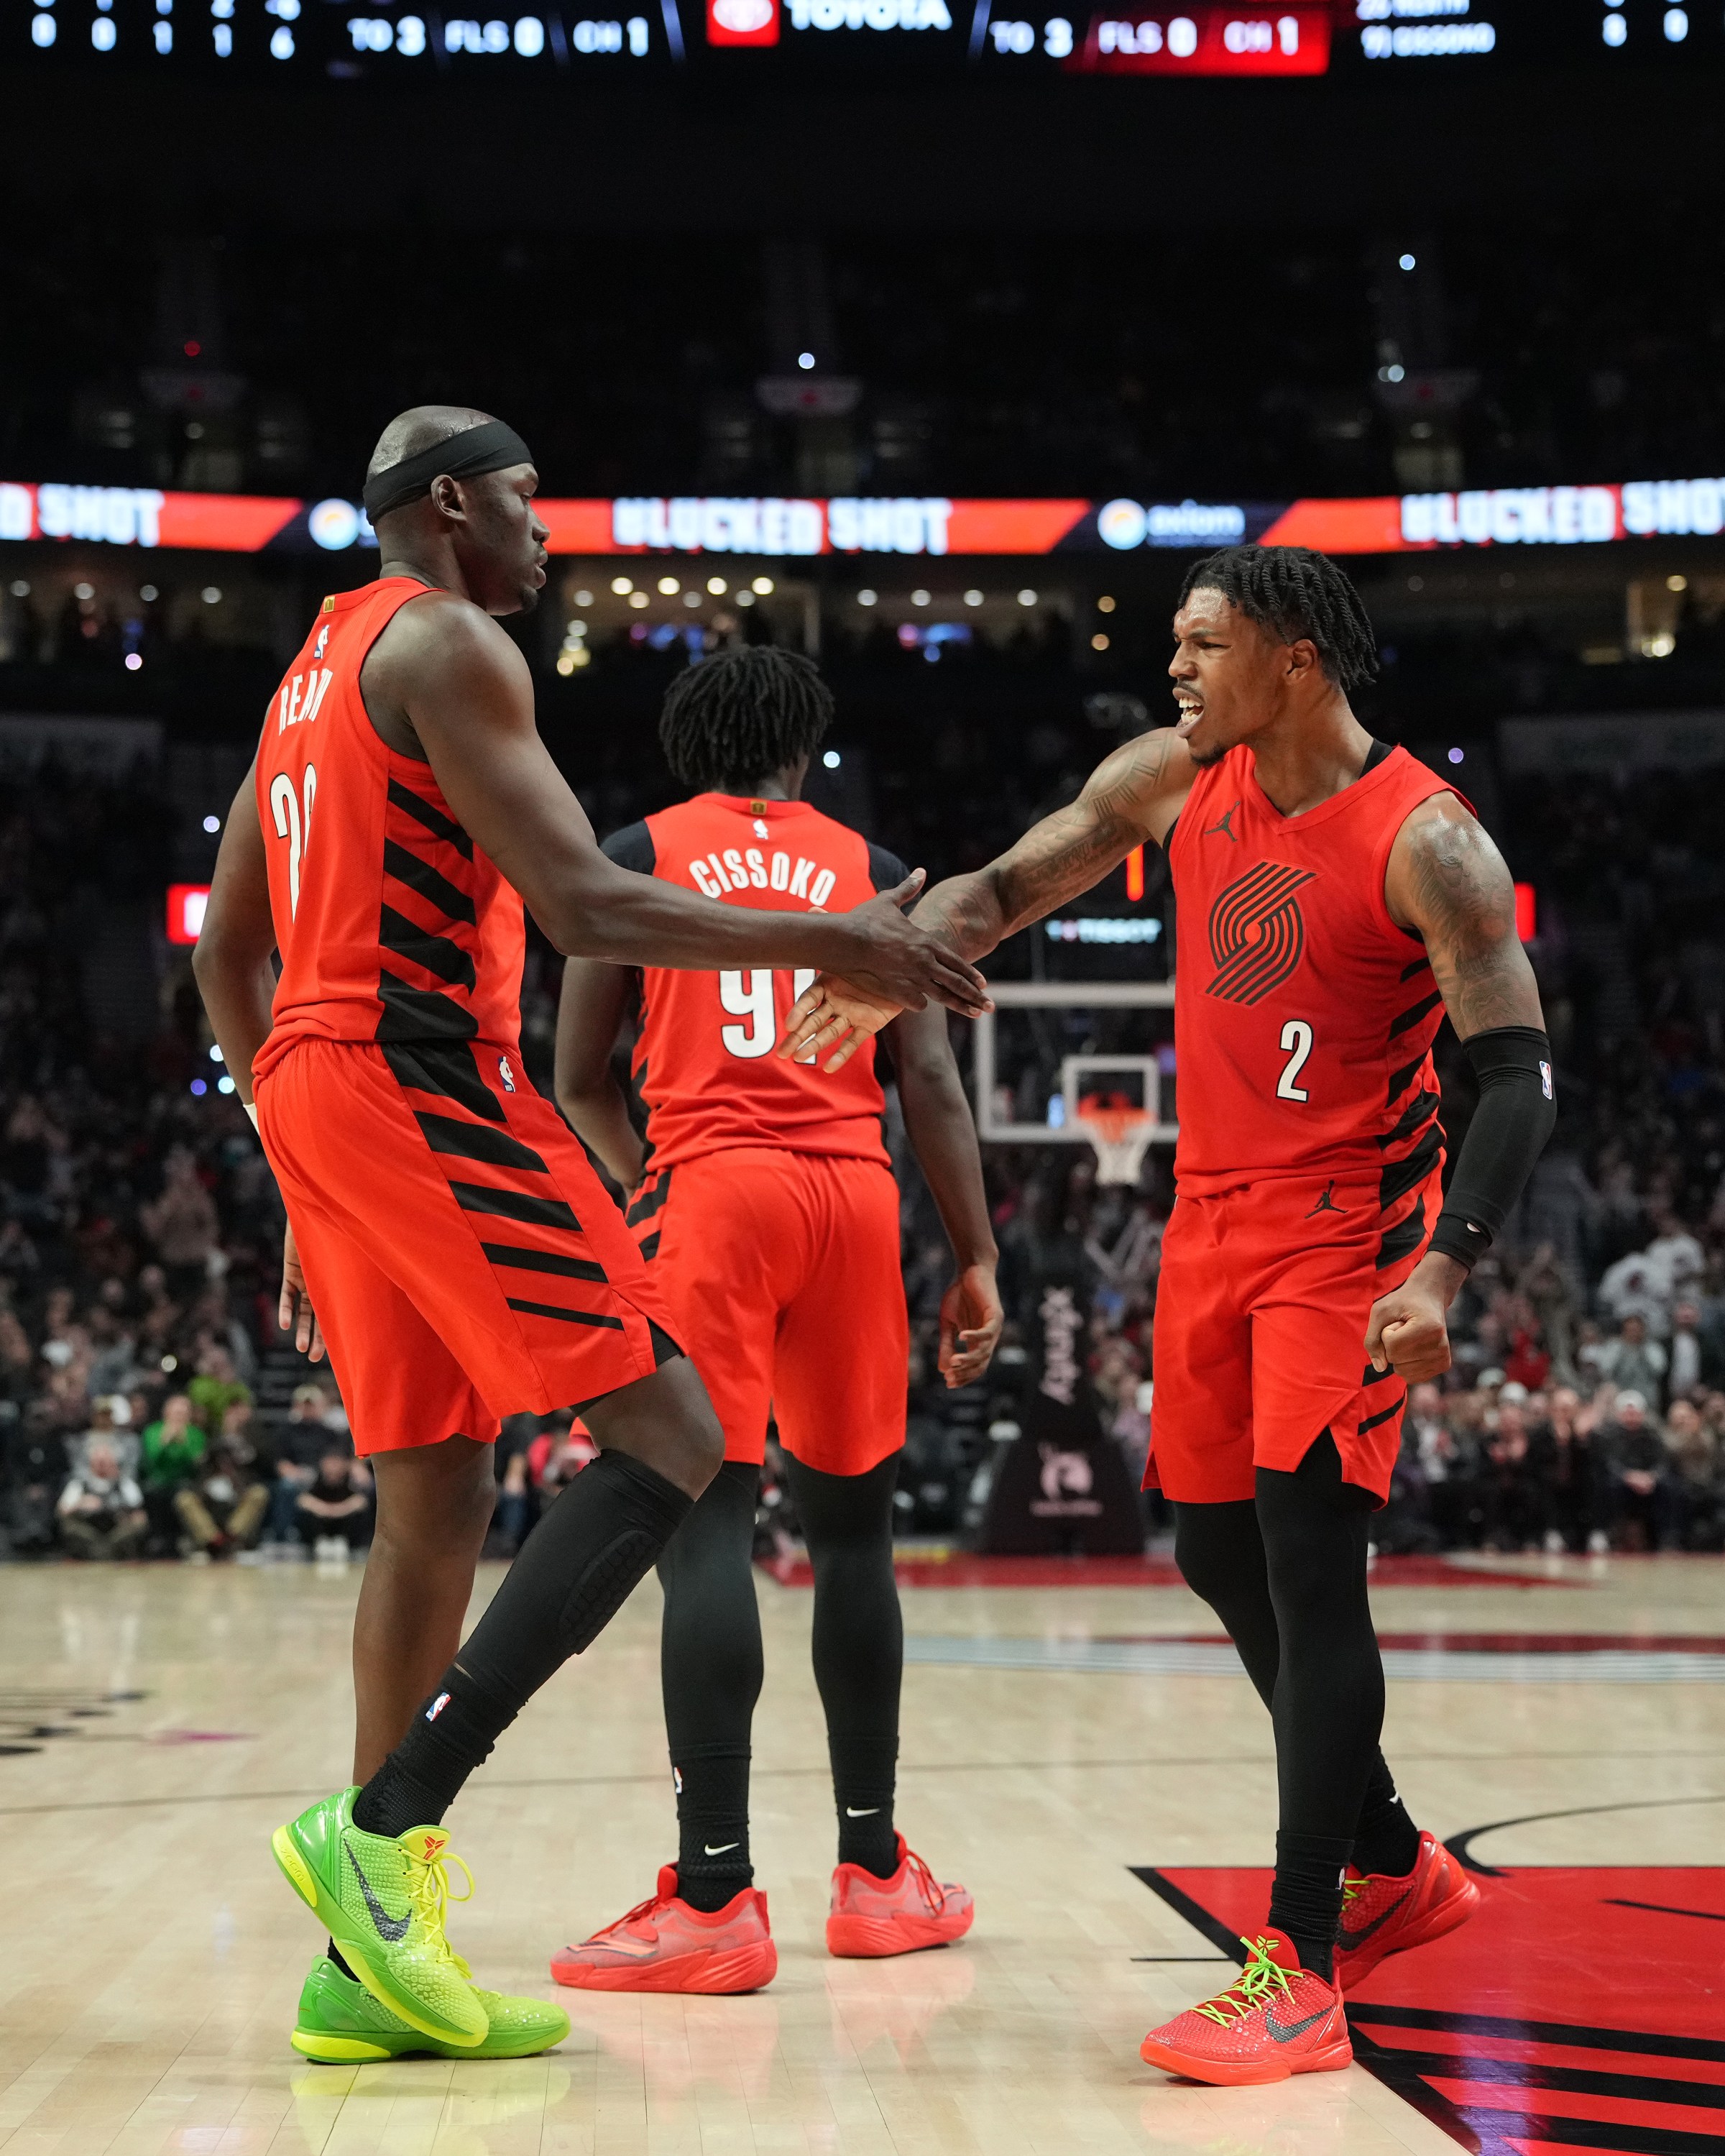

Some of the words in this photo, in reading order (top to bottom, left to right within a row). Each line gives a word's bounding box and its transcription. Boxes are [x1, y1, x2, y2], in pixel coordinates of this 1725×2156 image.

[38, 482, 165, 548] SHOT
[613, 497, 823, 555] BLOCKED
[828, 497, 951, 555] SHOT
[1401, 485, 1616, 544] BLOCKED
[689, 848, 837, 907] CISSOKO
[1276, 1019, 1314, 1104] 2
